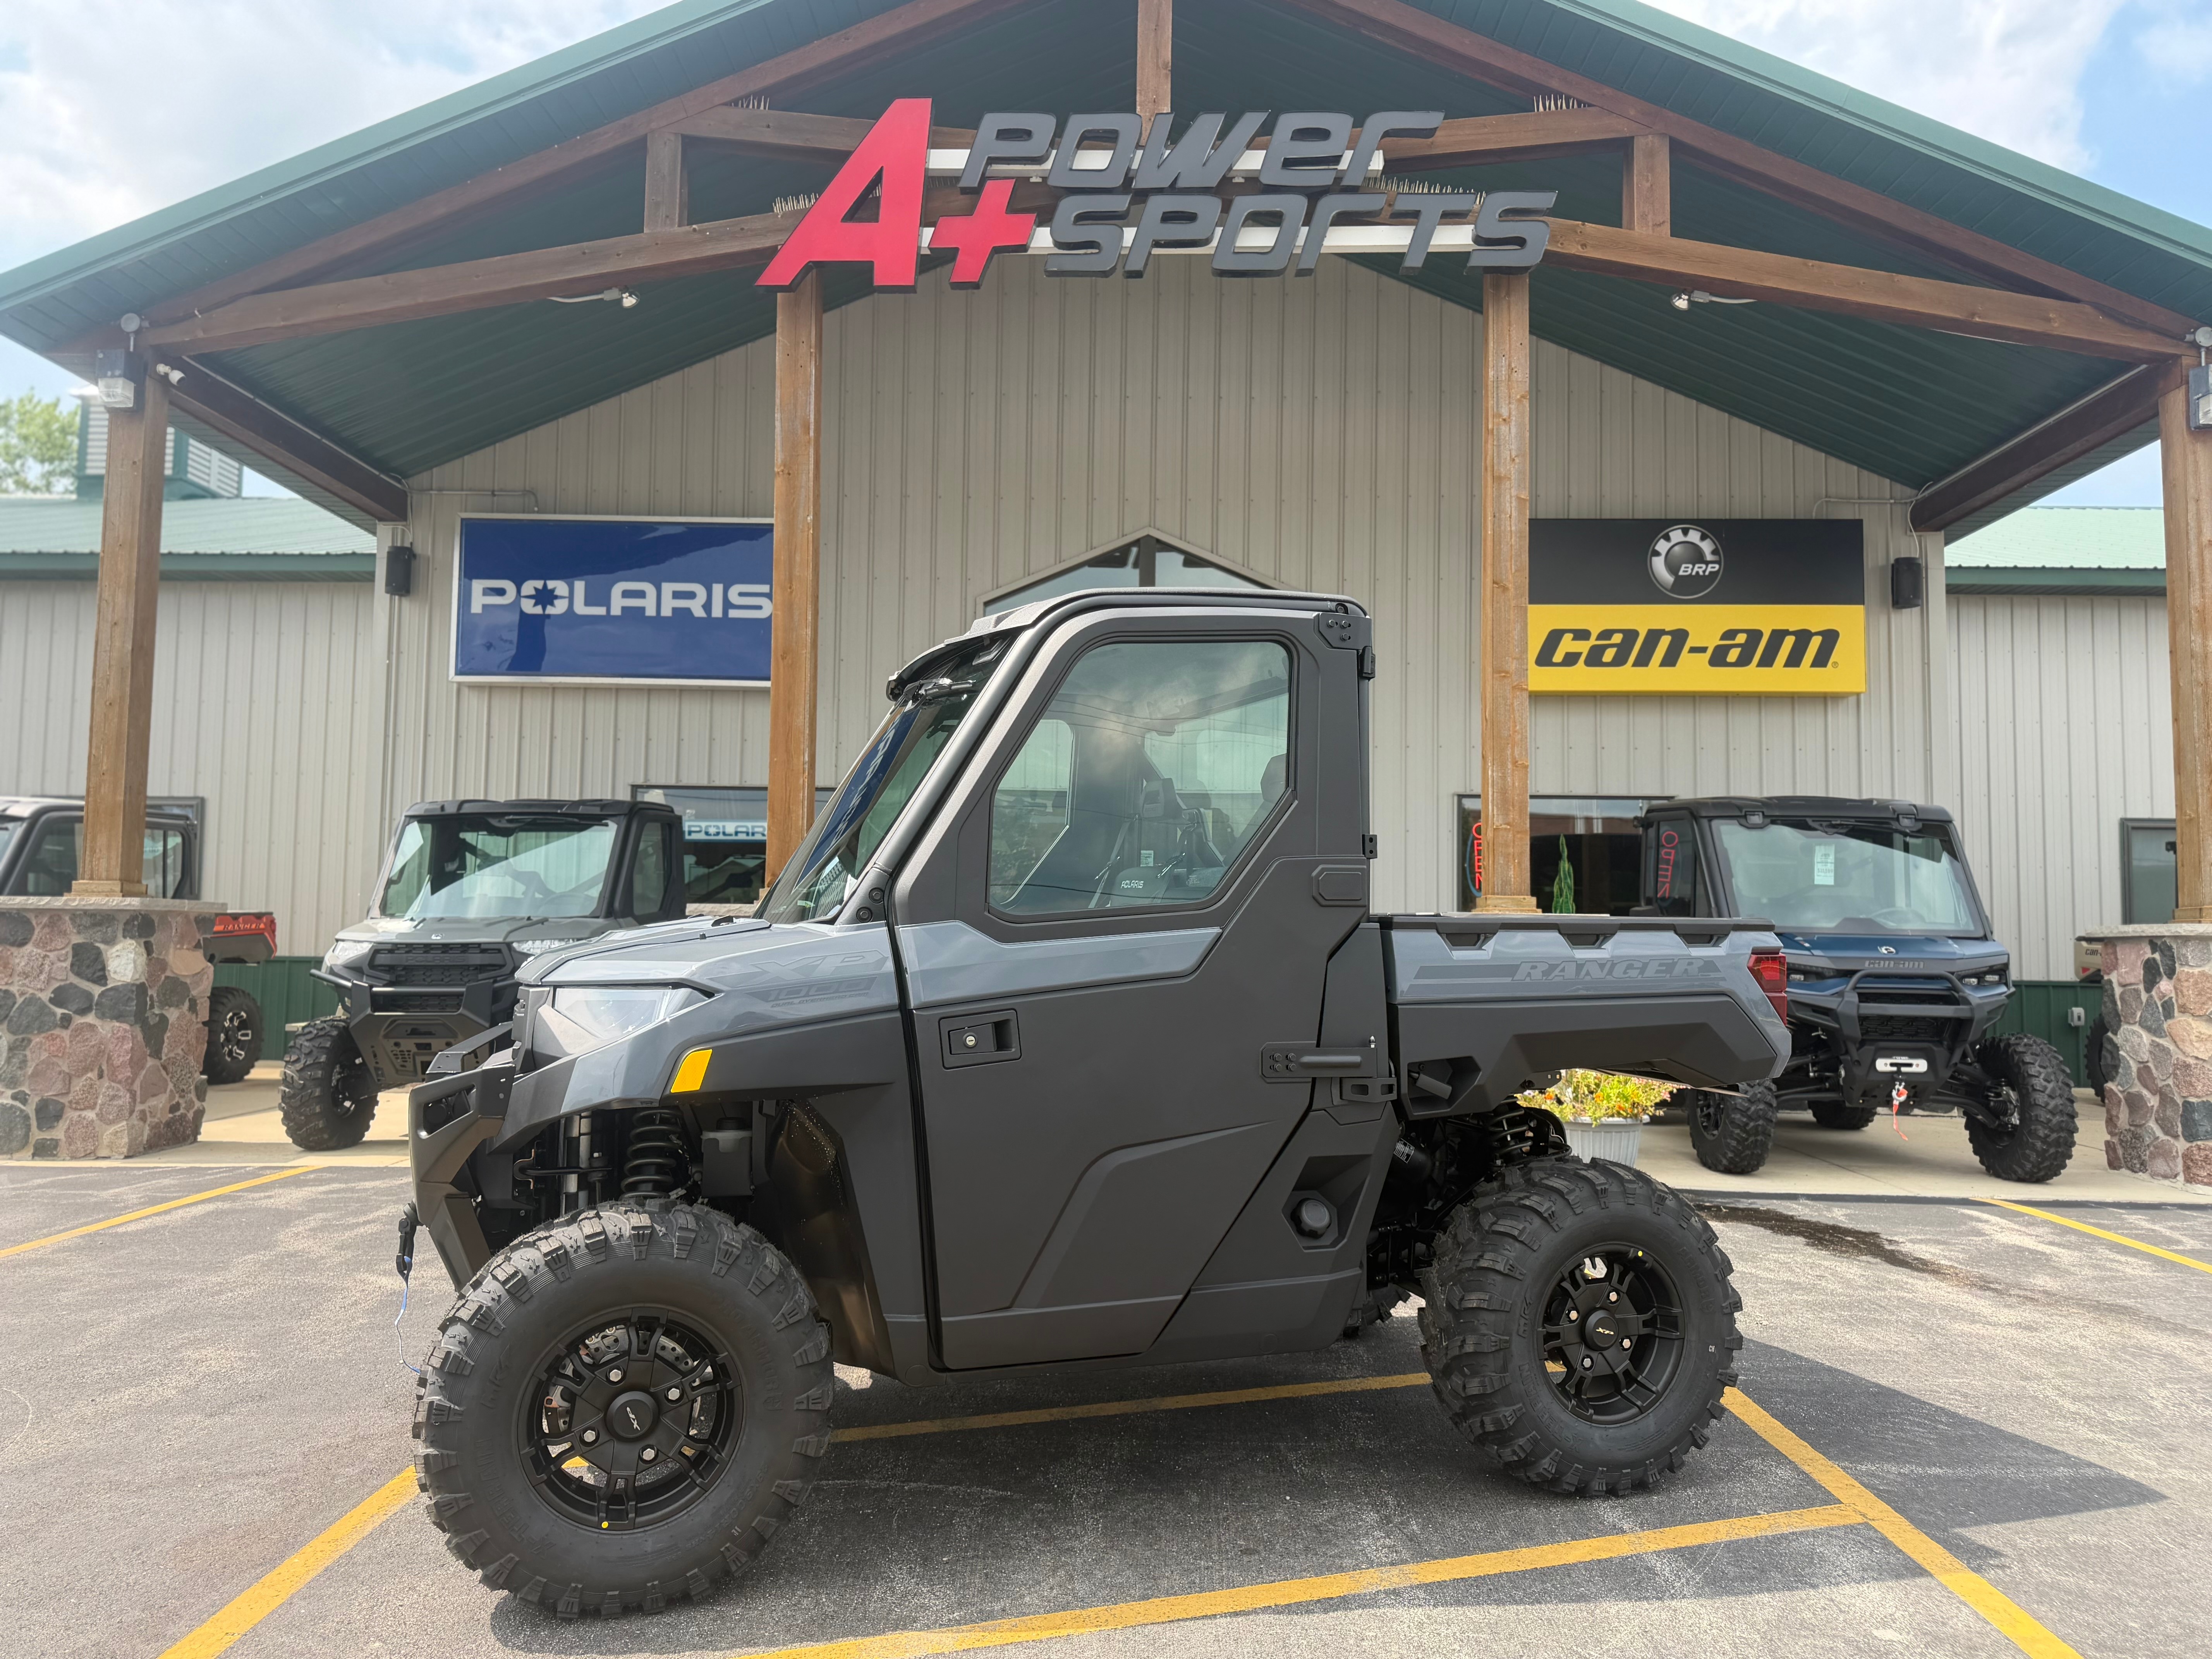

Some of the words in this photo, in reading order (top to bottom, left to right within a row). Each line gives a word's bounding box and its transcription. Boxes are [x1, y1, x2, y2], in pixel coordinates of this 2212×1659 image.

[1678, 563, 1719, 576] BRP
[470, 579, 773, 619] POLARIS
[1120, 880, 1145, 889] POLARIS
[405, 955, 467, 963] POLARIS
[735, 949, 886, 987] XP
[1511, 957, 1705, 981] RANGER
[768, 979, 869, 1001] 1000
[798, 994, 847, 1005] OVERHEAD
[1595, 1327, 1615, 1336] XP
[626, 1406, 642, 1431] XP
[474, 1437, 557, 1560] X-TERRAIN
